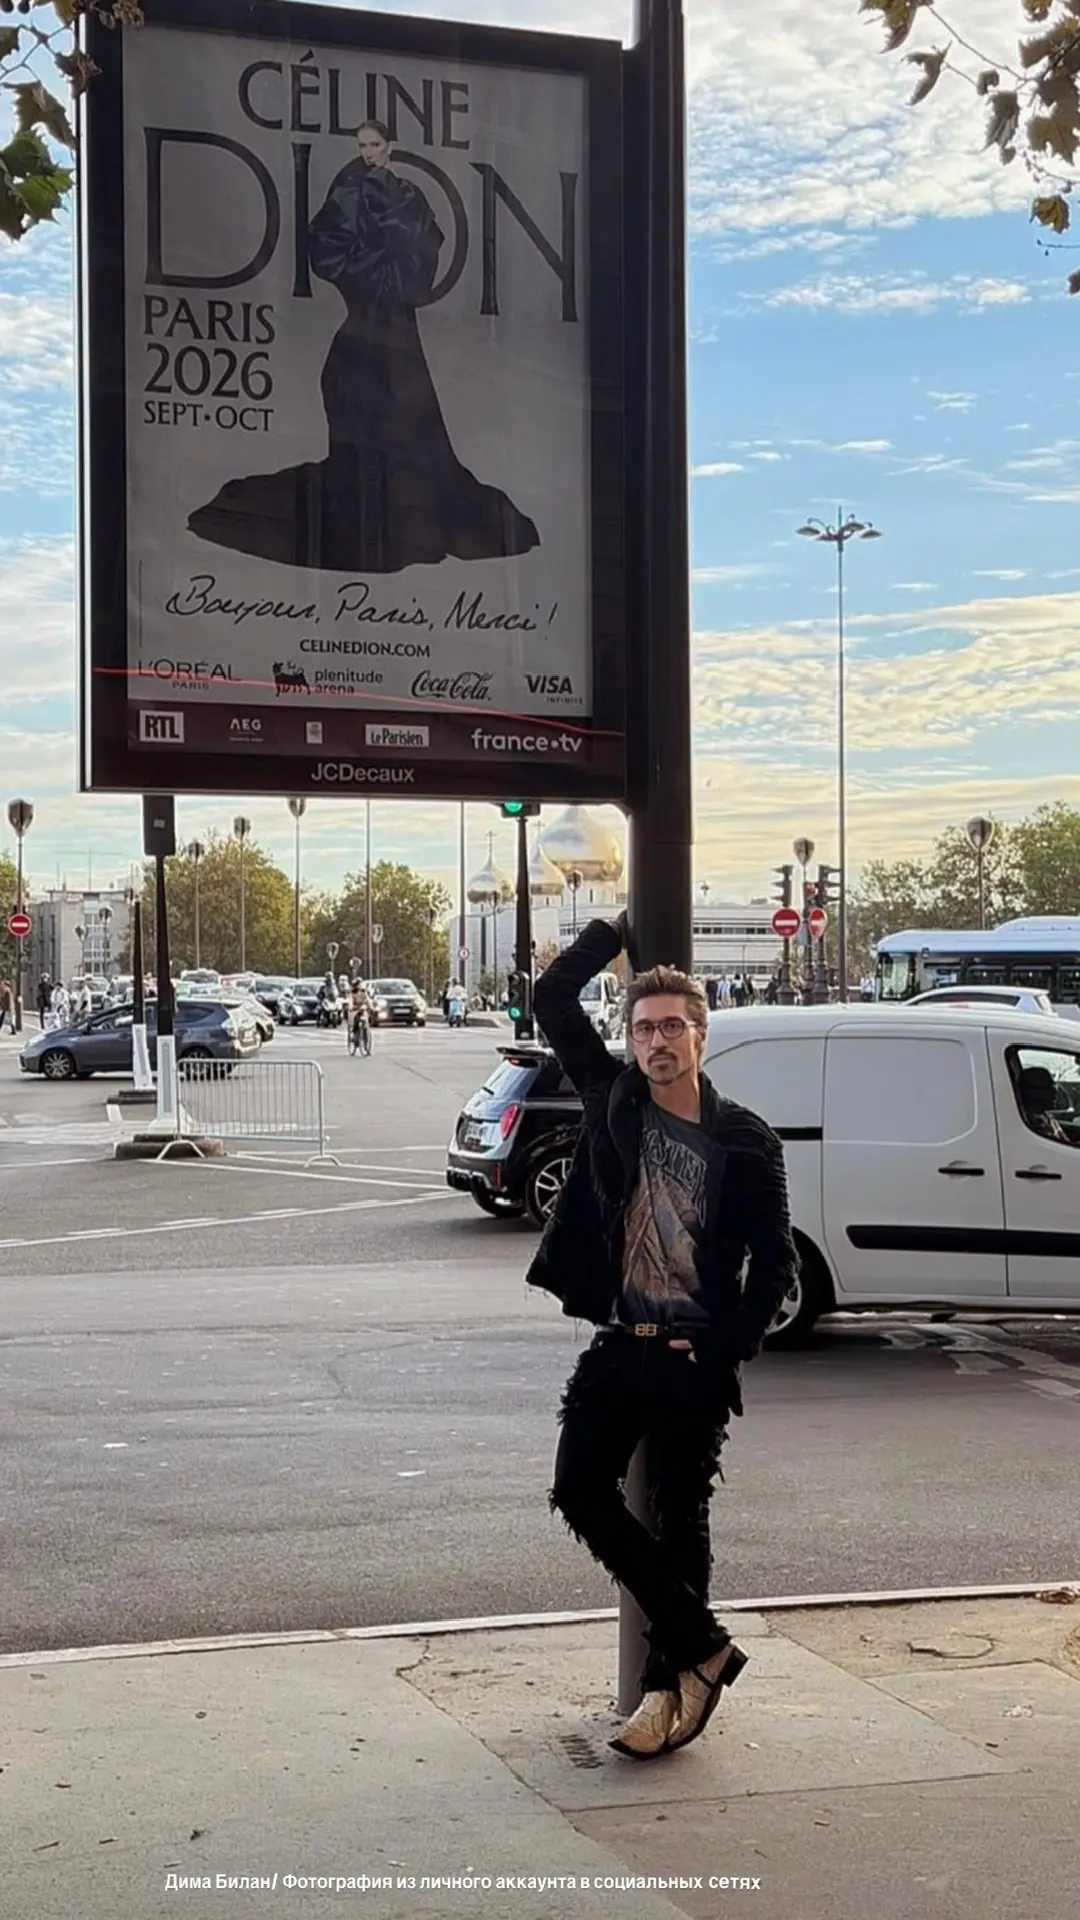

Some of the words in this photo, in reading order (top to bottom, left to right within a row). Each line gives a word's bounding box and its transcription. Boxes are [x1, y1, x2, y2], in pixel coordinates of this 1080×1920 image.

[238, 49, 470, 151] CÉLINE
[143, 294, 276, 345] PARIS
[144, 342, 273, 401] 2026
[334, 582, 434, 632] Paris,
[299, 638, 431, 658] CELINEDION.COM
[314, 667, 383, 687] plenitude
[525, 674, 573, 694] VISA
[315, 683, 355, 695] arena
[144, 714, 180, 739] RTL
[229, 717, 262, 731] AEG
[310, 763, 415, 783] JCDecaux
